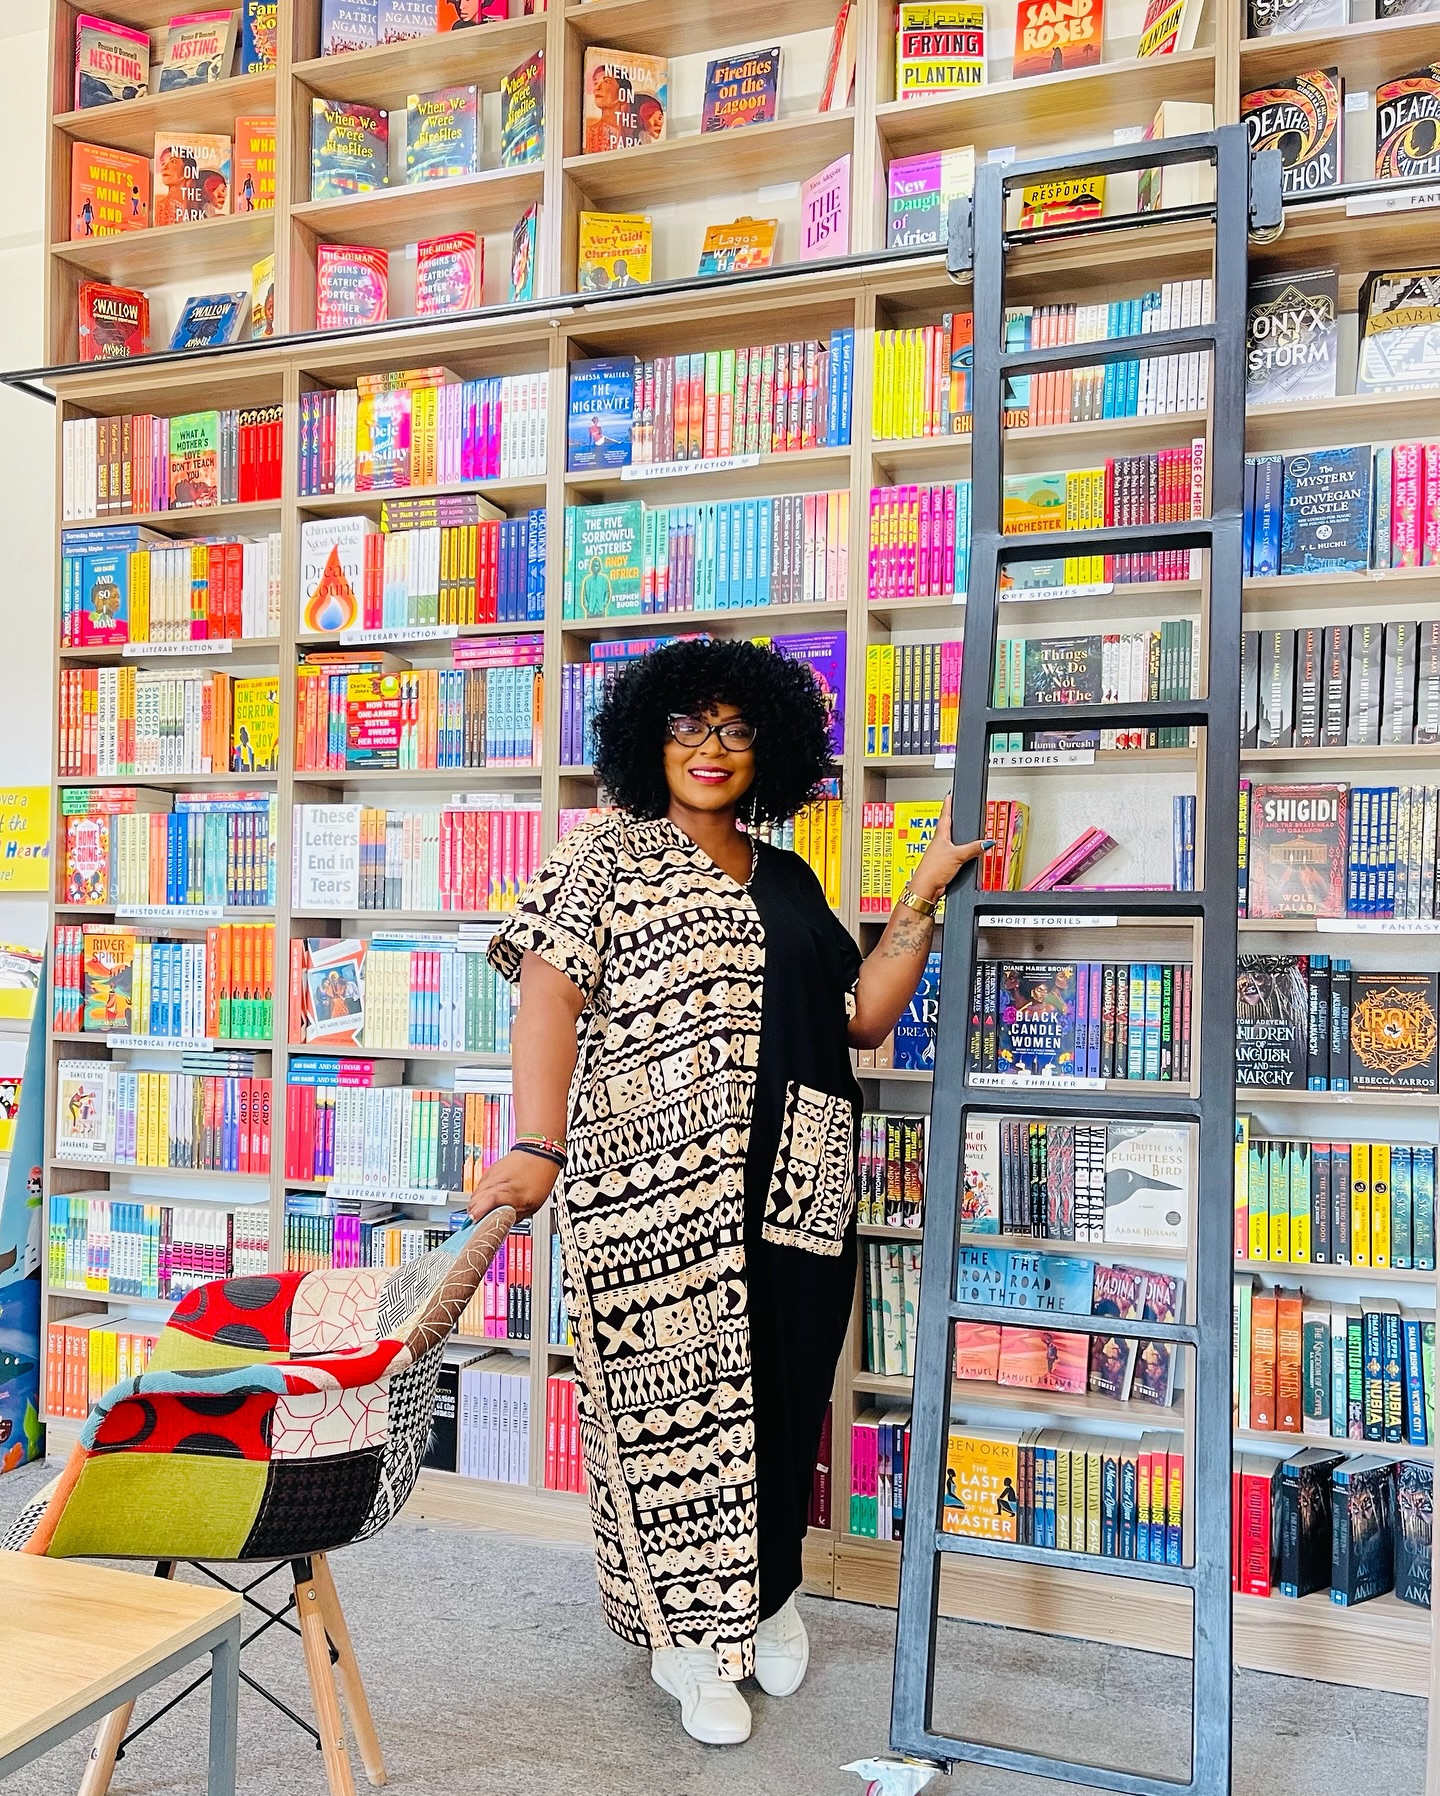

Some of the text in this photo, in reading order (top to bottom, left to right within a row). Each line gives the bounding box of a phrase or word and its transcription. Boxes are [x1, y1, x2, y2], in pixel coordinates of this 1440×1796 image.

[1023, 17, 1095, 51] ROSES
[171, 37, 219, 60] NESTING
[908, 34, 979, 55] FRYING
[89, 48, 142, 82] NESTING
[714, 59, 772, 84] Fireflies
[604, 63, 653, 84] NERUDA
[904, 66, 982, 85] PLANTAIN
[618, 87, 635, 104] ON
[718, 79, 765, 99] on the
[418, 98, 466, 116] When We
[714, 96, 766, 117] Lagoon
[324, 111, 377, 131] When We
[427, 113, 455, 128] Were
[614, 111, 638, 129] THE
[335, 127, 365, 143] Were
[418, 127, 463, 145] Fireflies
[170, 144, 217, 160] NERUDA
[325, 140, 374, 159] Fireflies
[89, 165, 134, 188] WHAT'S
[184, 166, 200, 180] ON
[180, 187, 203, 202] THE
[894, 179, 927, 196] New
[1031, 182, 1096, 202] RESPONSE
[96, 187, 126, 206] MINE
[808, 186, 841, 223] THE
[99, 205, 123, 224] AND
[806, 208, 842, 249] LIST
[892, 215, 908, 231] of
[718, 233, 758, 246] Lagos
[891, 229, 937, 248] Africa
[584, 245, 647, 260] Christmas
[321, 265, 358, 275] ORIGINS
[321, 277, 364, 288] BEATRICE
[92, 297, 139, 320] SWALLOW
[189, 302, 232, 320] SWALLOW
[331, 303, 360, 314] OTHER
[1253, 305, 1329, 339] ONYX
[1249, 341, 1330, 371] STORM
[574, 371, 630, 382] VANESSA WALTERS
[591, 383, 611, 397] THE
[572, 396, 630, 413] NIGERWIFE
[176, 437, 209, 451] MOTHER'S
[183, 449, 201, 460] LOVE
[171, 457, 215, 472] DON'T TEACH
[645, 459, 735, 476] LITERARY FICTION
[1192, 444, 1203, 518] EDGE OF HERE
[1296, 471, 1357, 488] MYSTERY
[1290, 488, 1362, 507] DUNVEGAN
[1300, 501, 1350, 516] CASTLE
[585, 516, 623, 531] THE FIVE
[1004, 518, 1062, 534] ANCHESTER
[582, 528, 636, 545] SORROWFUL
[585, 541, 633, 556] MYSTERIES
[578, 556, 628, 570] OF ANDY
[305, 562, 359, 581] Dream
[610, 567, 640, 580] AFRICA
[95, 574, 114, 586] AND
[98, 589, 111, 599] SO
[306, 580, 356, 600] Count
[611, 592, 640, 603] STEPHEN
[1029, 588, 1078, 600] STORIES
[616, 599, 640, 608] BUORO
[93, 618, 117, 630] ROAR
[360, 629, 437, 642] LITERARY FICTION
[142, 644, 213, 654] LITERARY FICTION
[1041, 647, 1088, 662] Things
[1041, 661, 1087, 675] We Do
[1052, 675, 1076, 689] Not
[1035, 689, 1092, 704] Tell The
[366, 700, 398, 709] HOW THE
[357, 709, 398, 719] ONE-ARMED
[364, 719, 390, 727] SISTER
[368, 727, 397, 736] SWEEPS
[358, 736, 398, 746] HER HOUSE
[1030, 738, 1094, 750] Huma Qureshi
[1011, 755, 1060, 765] STORIES
[310, 808, 355, 824] These
[1264, 799, 1338, 823] SHIGIDI
[9, 814, 27, 831] the
[78, 831, 98, 842] HOME
[305, 831, 358, 847] Letters
[6, 841, 51, 858] Heard
[77, 849, 98, 862] GOING
[308, 854, 354, 870] End in
[310, 877, 351, 894] Tears
[1282, 894, 1314, 902] WOLE
[130, 908, 210, 917] HISTORICAL FICTION
[1278, 903, 1317, 912] TALABI
[990, 917, 1081, 925] SHORT STORIES
[92, 939, 125, 952] RIVER
[92, 951, 126, 964] SPIRIT
[1003, 965, 1073, 973] DIANE MARIE BROWN
[1015, 1011, 1059, 1023] BLACK
[1364, 1007, 1421, 1028] IRON
[1011, 1024, 1062, 1036] CANDLE
[119, 1038, 199, 1049] HISTORICAL FICTION
[1011, 1036, 1062, 1049] WOMEN
[1359, 1031, 1427, 1050] FLAME
[972, 1078, 1005, 1086] CRIME
[1024, 1079, 1077, 1087] THRILLER
[1352, 1076, 1435, 1087] REBECCA YARROS
[240, 1091, 248, 1125] GLORY
[441, 1107, 450, 1146] EQUATOR
[1129, 1142, 1183, 1153] TRUTH IS A
[1111, 1152, 1183, 1165] FLIGHTLESS
[1151, 1164, 1182, 1177] BIRD
[347, 1188, 425, 1201] LITERARY FICTION
[1114, 1226, 1178, 1238] AKBAR HUSSAIN
[1011, 1257, 1040, 1272] THE
[1010, 1275, 1052, 1291] ROAD
[1254, 1328, 1273, 1398] REBEL SISTERS
[1348, 1326, 1363, 1401] UNSETTLED GROUND
[1369, 1379, 1382, 1426] NUBIA
[948, 1438, 1015, 1459] BEN OKRI
[960, 1474, 999, 1488] LAST
[946, 1511, 1013, 1533] MASTER
